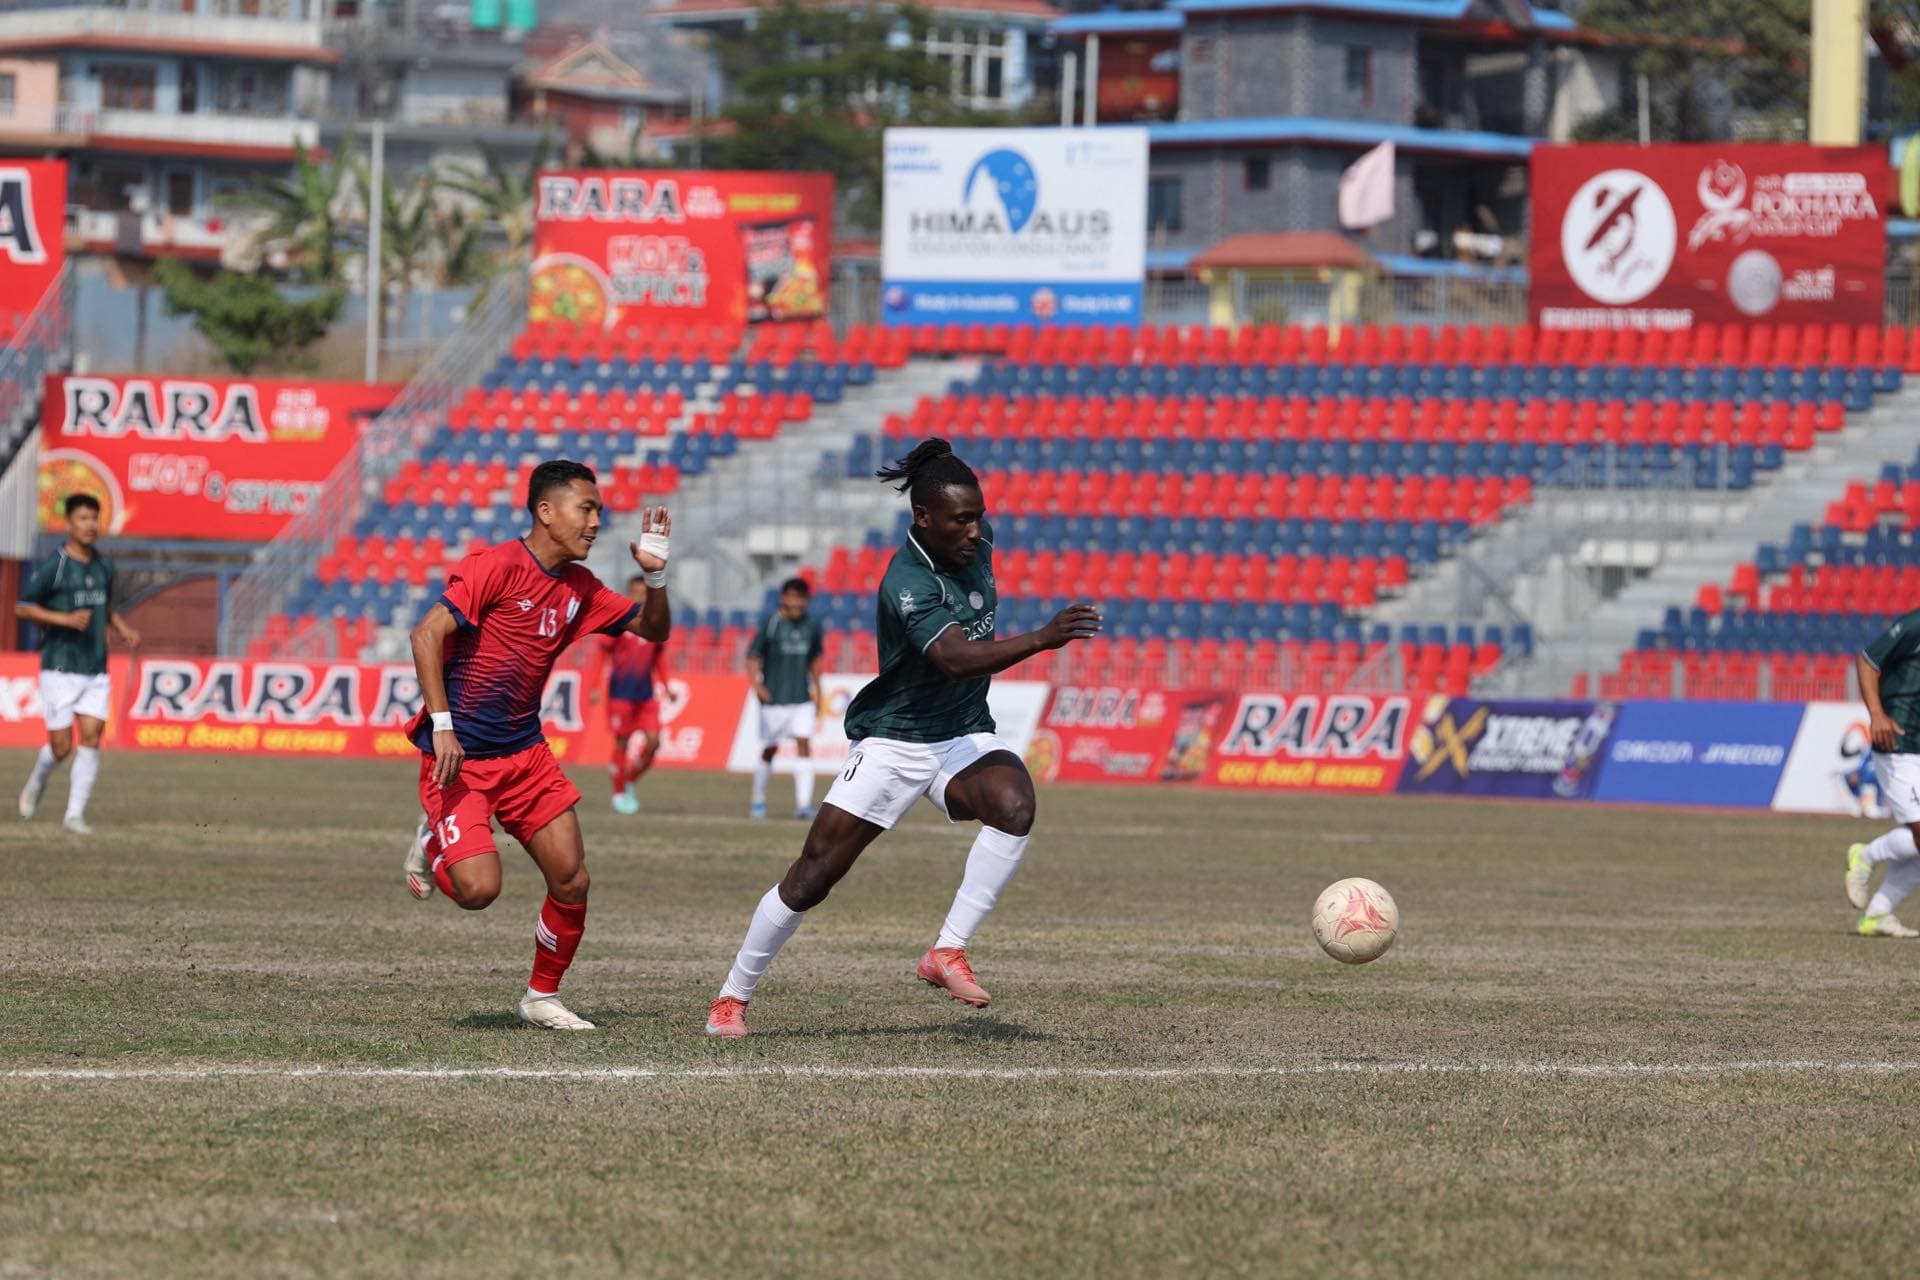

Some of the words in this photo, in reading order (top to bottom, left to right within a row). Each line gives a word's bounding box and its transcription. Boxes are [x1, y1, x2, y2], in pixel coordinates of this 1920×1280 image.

[538, 176, 685, 222] RARA
[1752, 190, 1879, 219] POKHARA
[62, 378, 267, 442] RARA
[538, 608, 558, 637] 13
[131, 660, 364, 725] RARA
[1048, 687, 1140, 728] RARA
[1219, 693, 1411, 759] RARA
[1477, 714, 1584, 756] XTREME
[437, 814, 461, 849] 13
